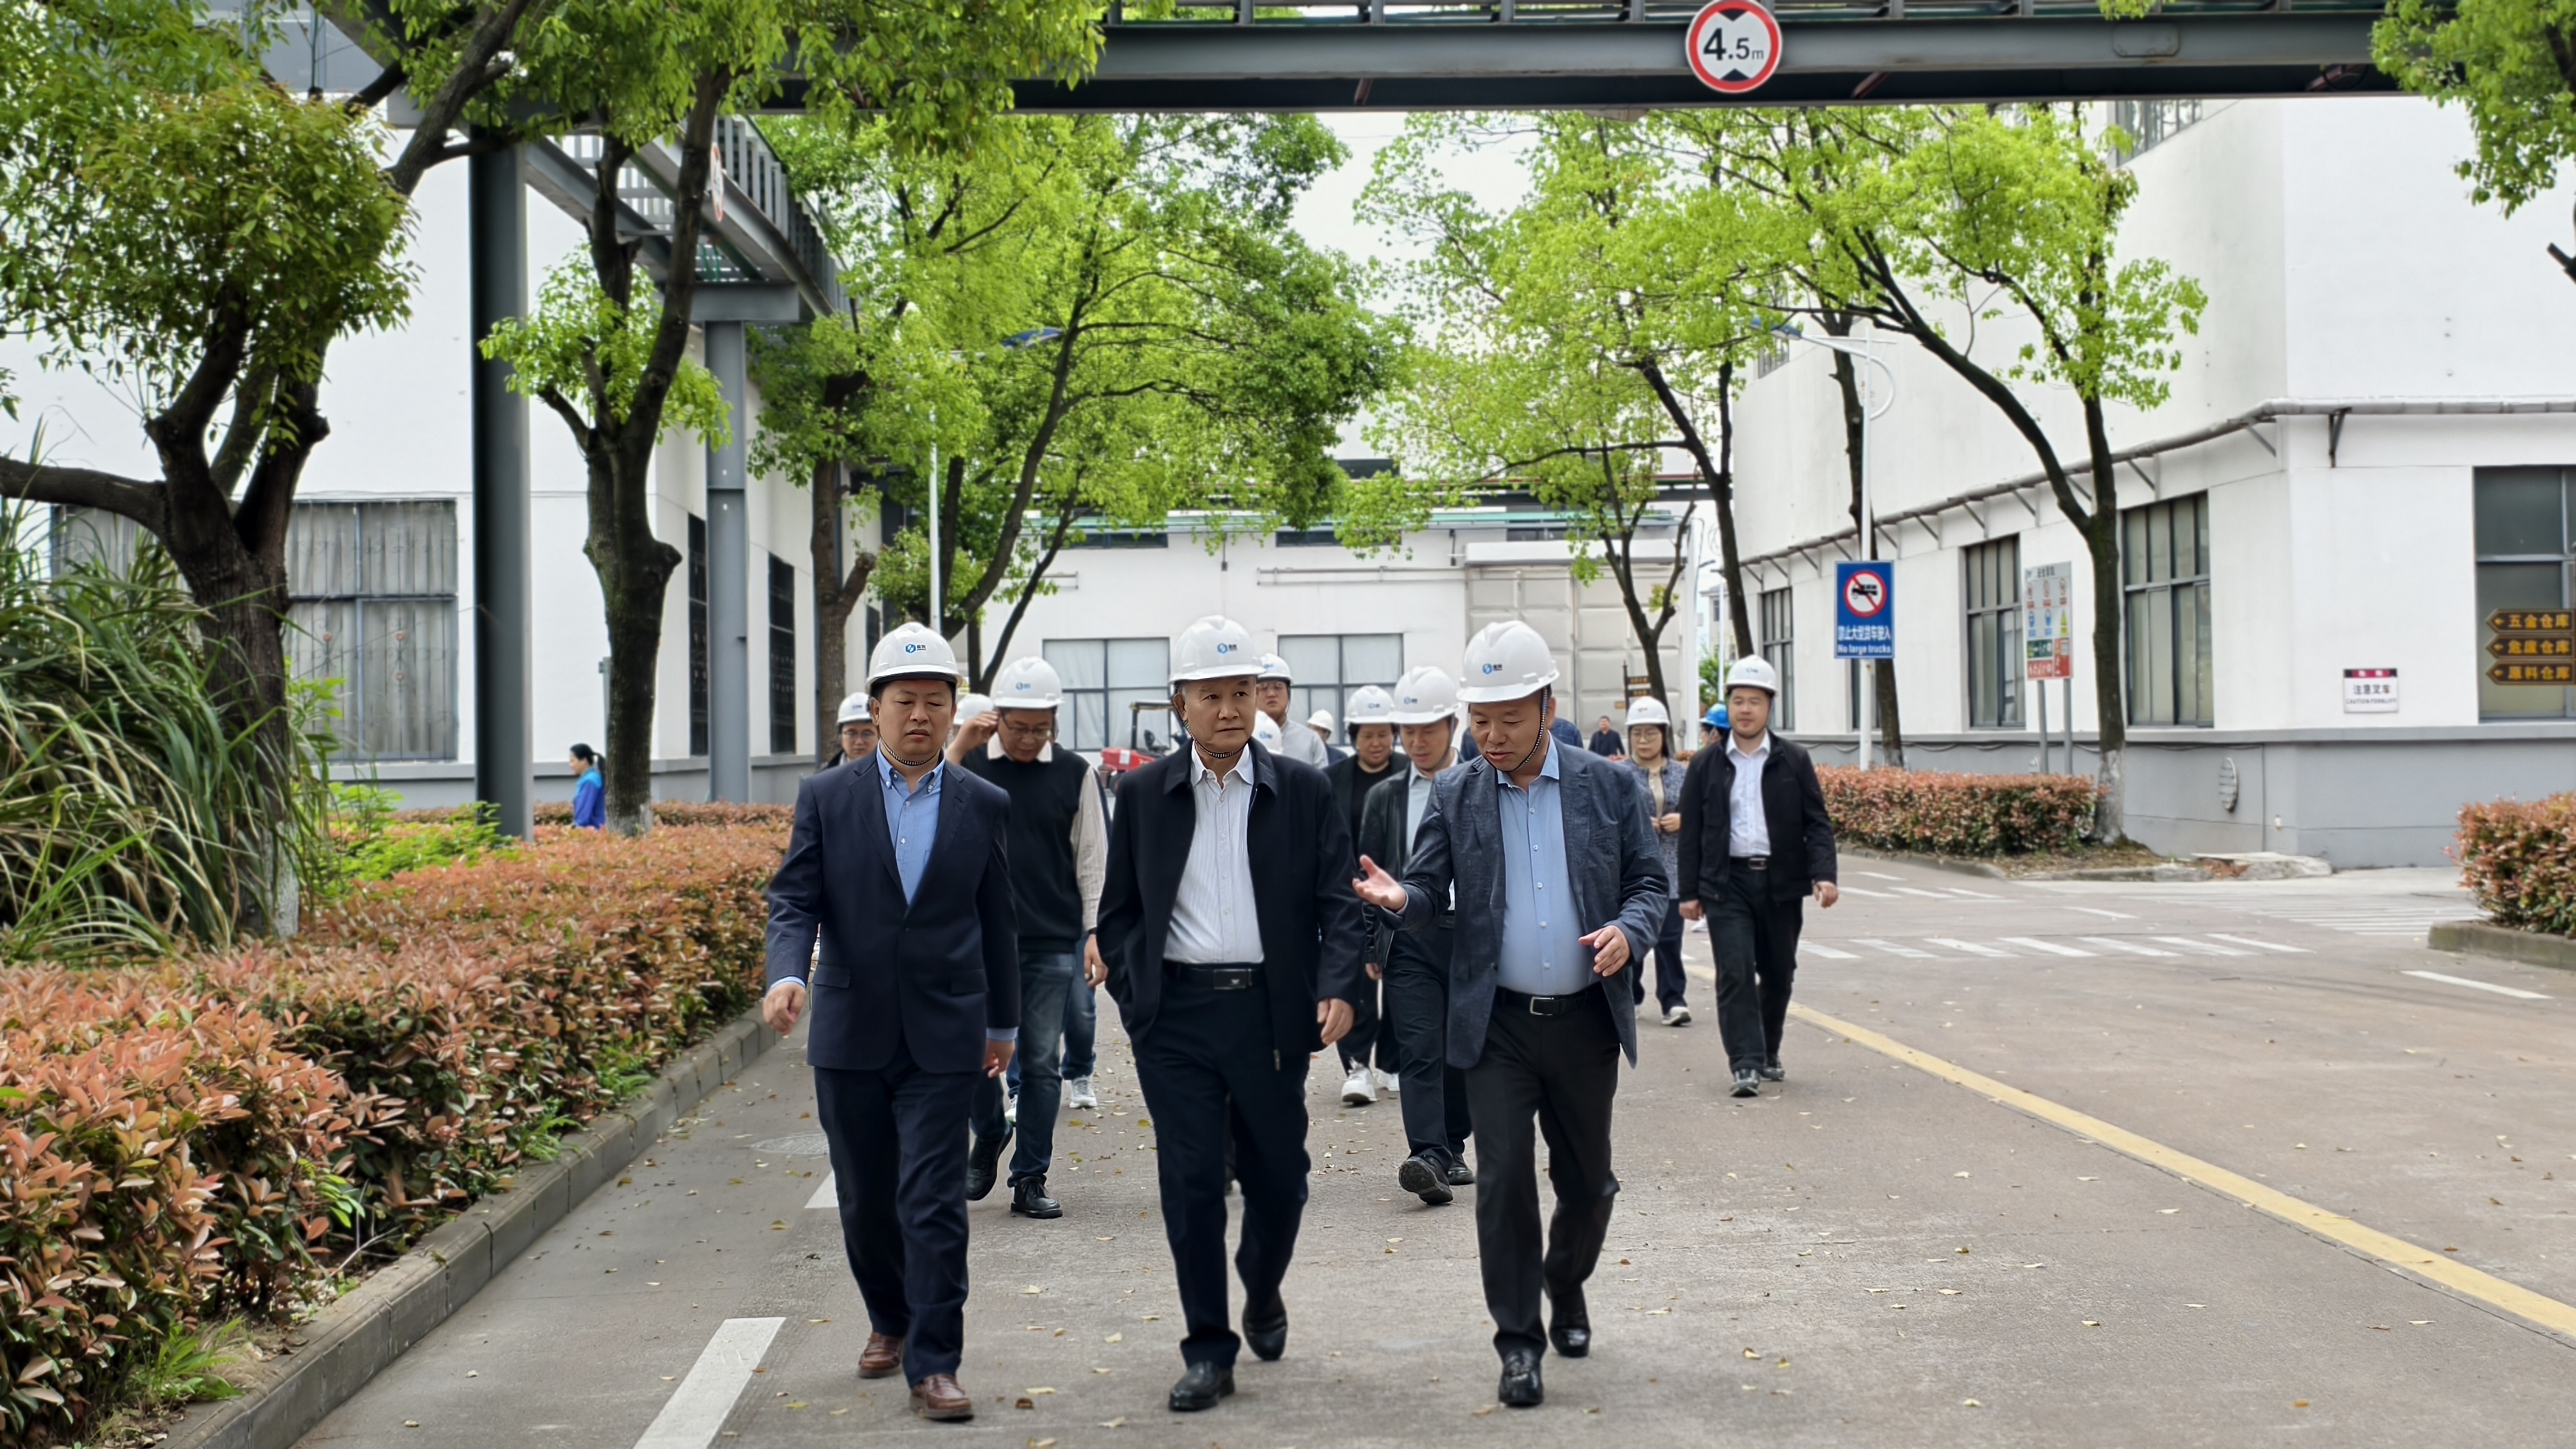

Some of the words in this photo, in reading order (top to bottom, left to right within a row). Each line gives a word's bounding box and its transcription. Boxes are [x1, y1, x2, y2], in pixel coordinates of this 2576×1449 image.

[1703, 28, 1764, 61] 4.5m
[2508, 614, 2569, 629] 五金仓库
[1837, 644, 1848, 653] No
[1849, 644, 1866, 656] large
[1868, 644, 1891, 653] trucks
[2508, 666, 2570, 680] 原料仓库
[2353, 684, 2391, 695] 注意叉车
